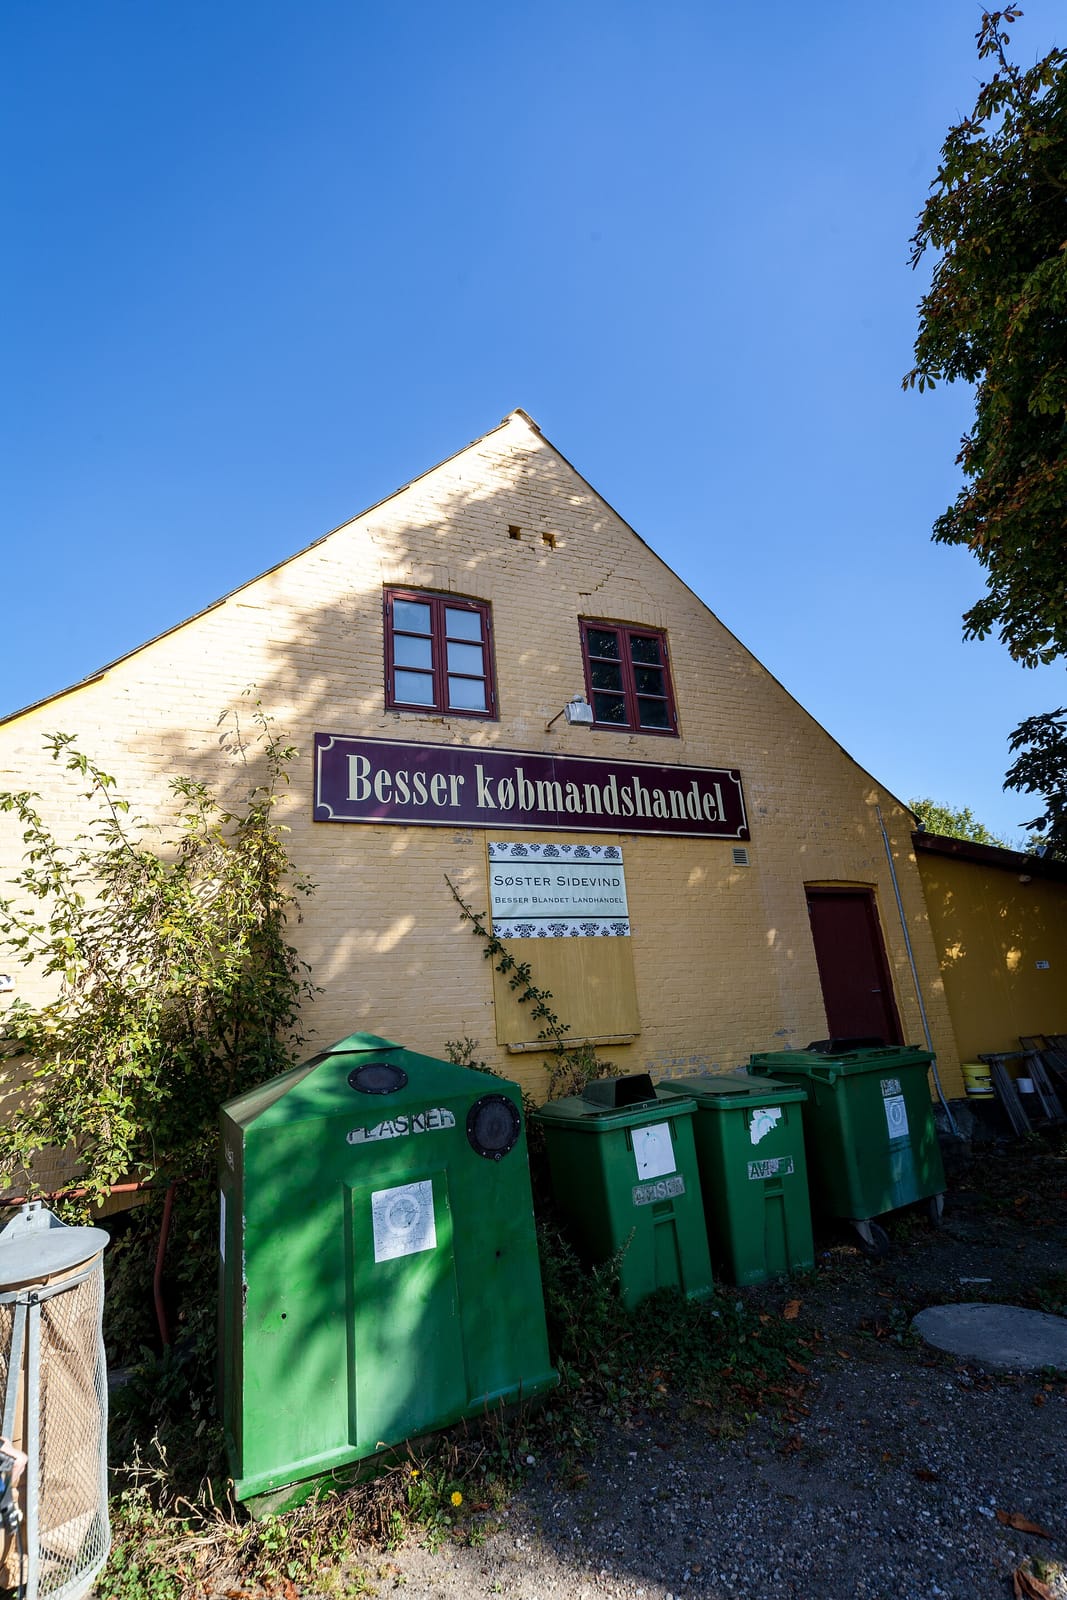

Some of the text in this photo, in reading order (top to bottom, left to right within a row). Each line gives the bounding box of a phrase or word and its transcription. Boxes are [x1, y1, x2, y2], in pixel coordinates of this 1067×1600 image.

[346, 754, 728, 822] Besser købmandshandel
[494, 875, 620, 887] SØSTER SIDEVIND
[494, 896, 624, 904] BESSER BLANDET LANDHANDEL
[348, 1107, 455, 1142] FLASKER
